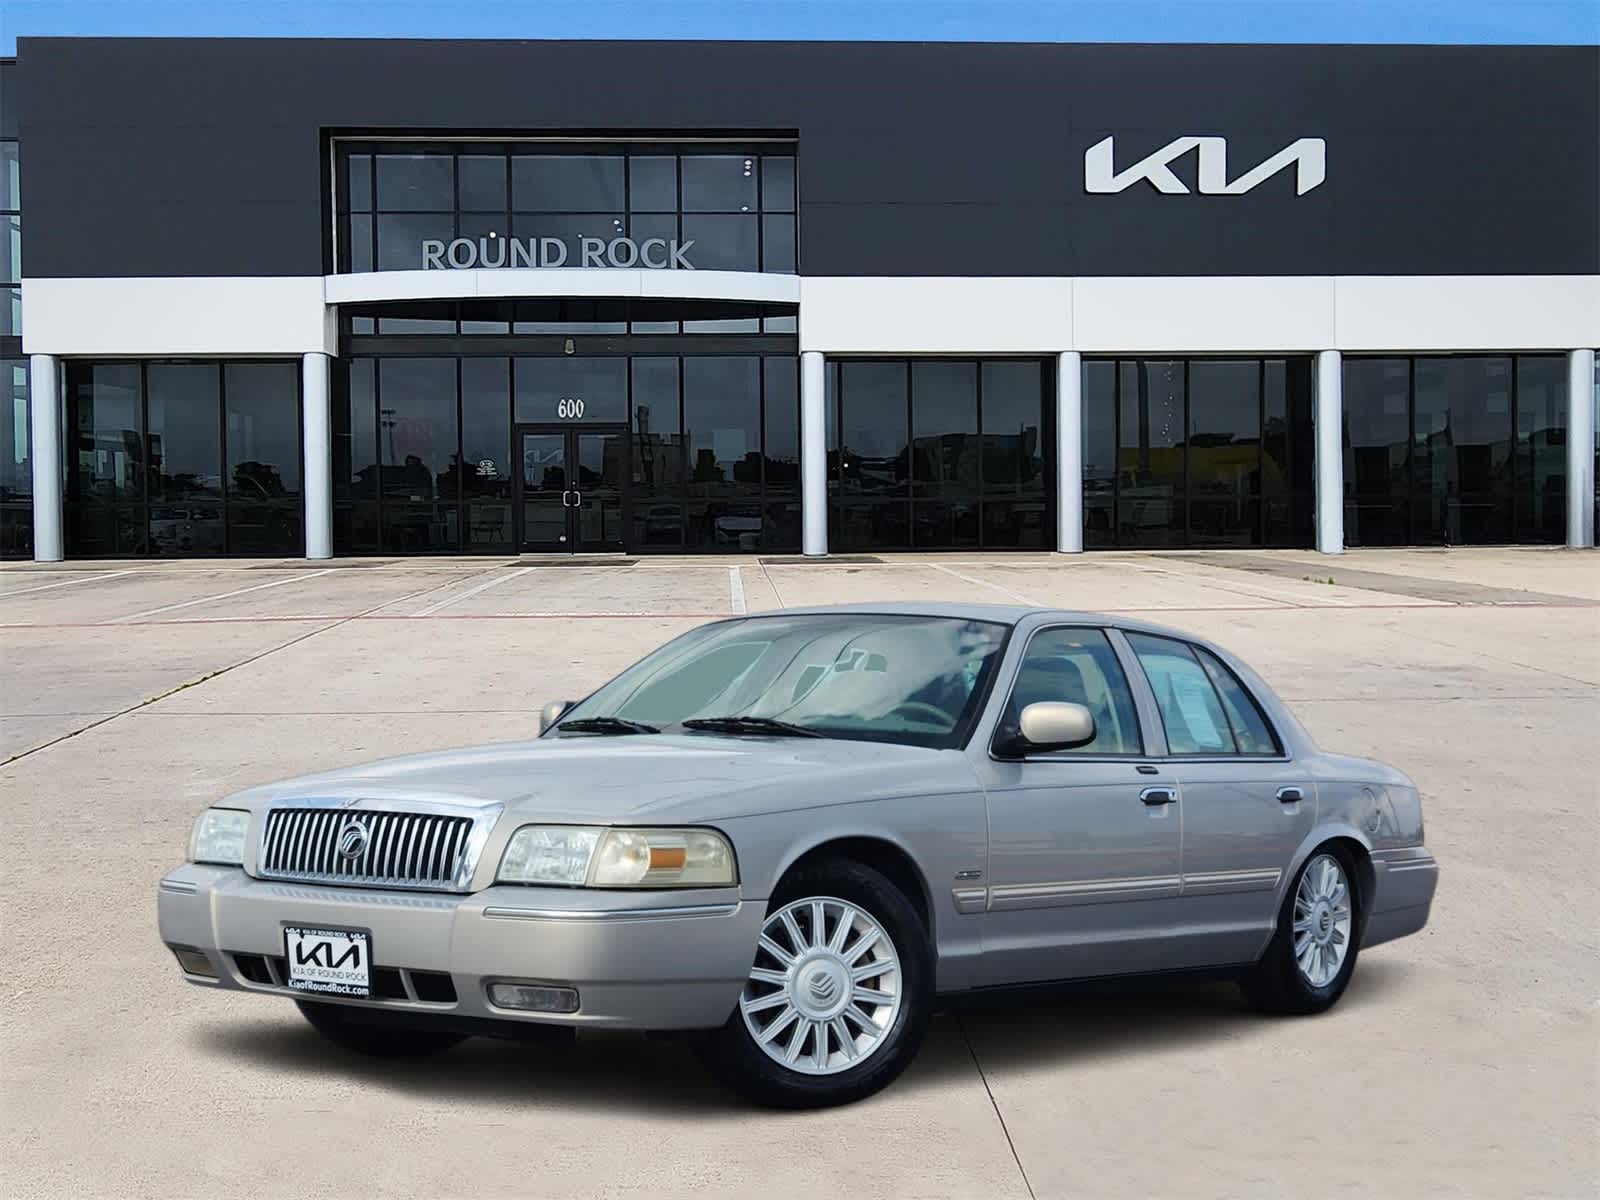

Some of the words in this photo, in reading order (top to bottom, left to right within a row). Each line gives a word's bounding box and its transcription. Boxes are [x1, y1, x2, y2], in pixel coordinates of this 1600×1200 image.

[1085, 135, 1326, 195] KIA
[422, 237, 567, 270] ROUND
[582, 237, 695, 270] ROCK
[557, 399, 585, 418] 600
[296, 941, 360, 970] KIA
[292, 967, 305, 975] KIA
[307, 968, 317, 976] OF
[318, 969, 344, 980] ROUND
[345, 972, 367, 981] ROCK
[288, 979, 369, 996] KiaofRoundRock.com
